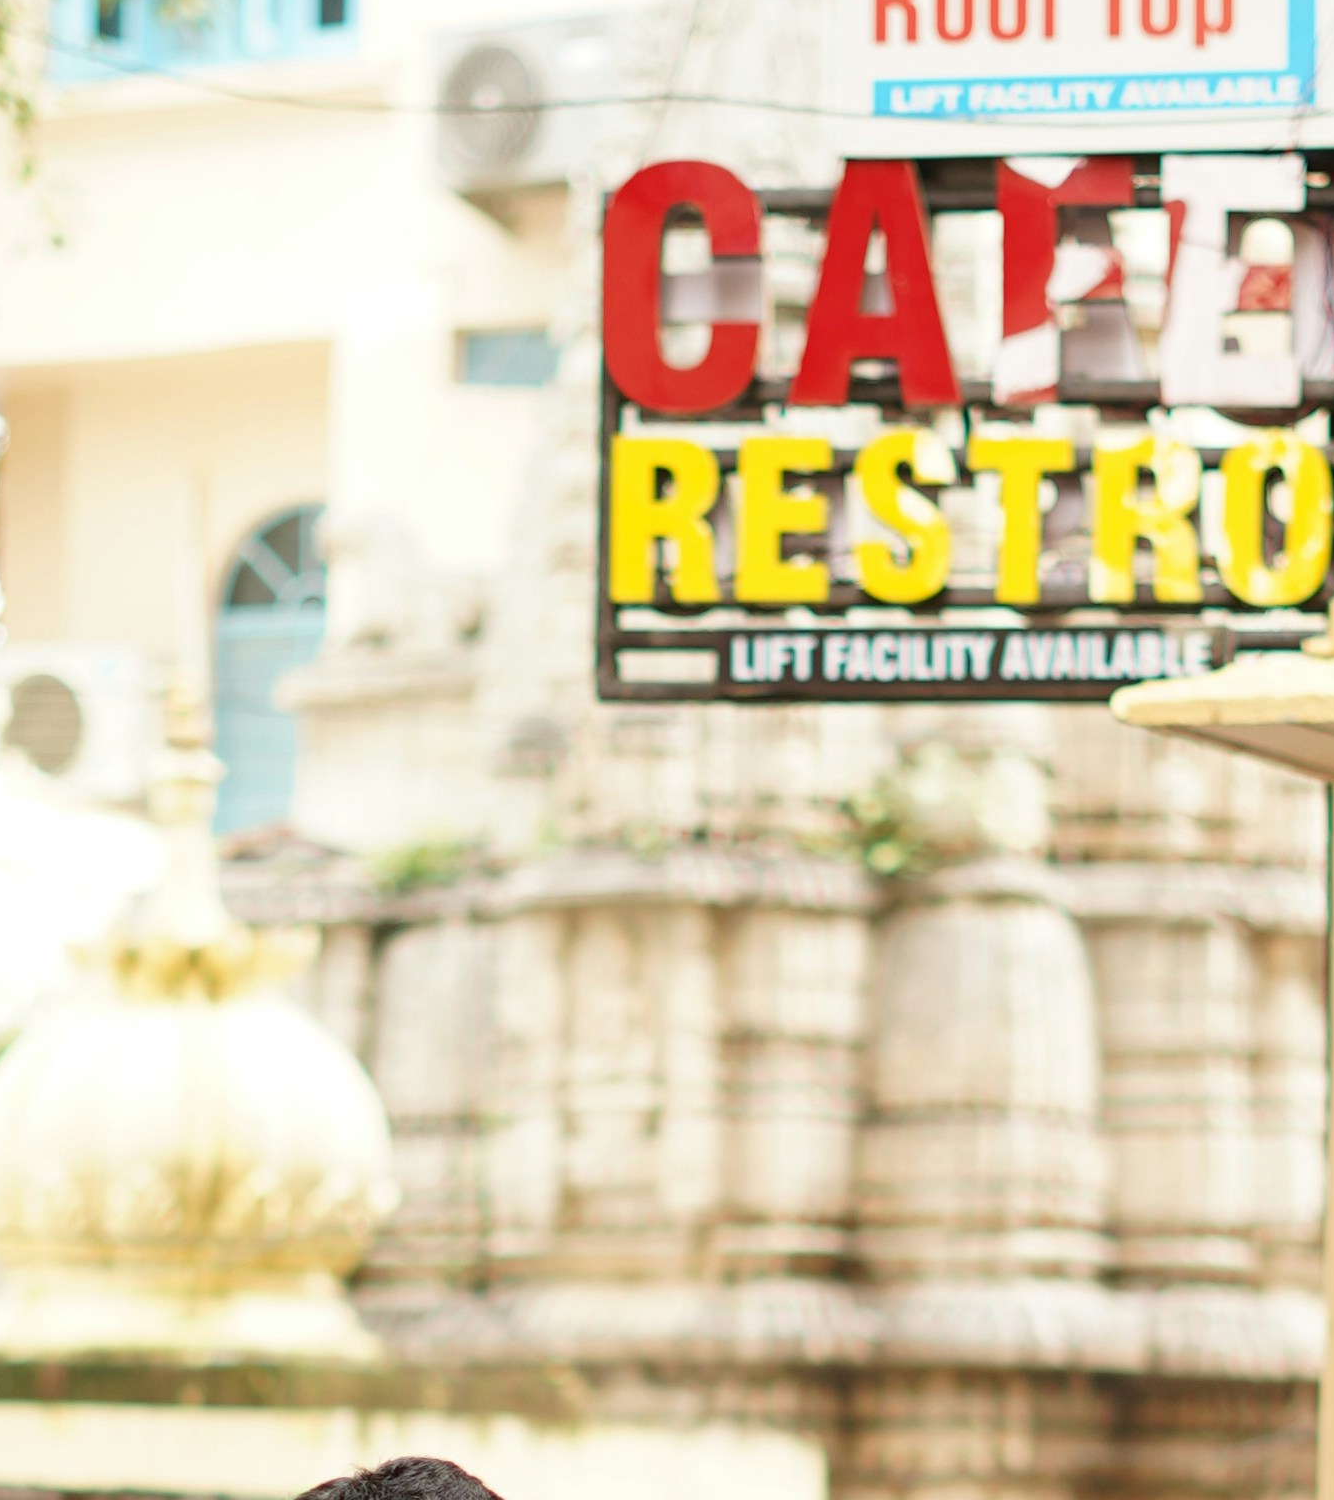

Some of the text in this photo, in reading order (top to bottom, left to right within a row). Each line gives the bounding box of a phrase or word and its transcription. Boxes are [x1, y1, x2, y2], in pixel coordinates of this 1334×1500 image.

[890, 76, 1302, 114] LIFT FACILITY AVAILABLE
[604, 159, 1306, 412] CAFE
[610, 428, 1334, 606] RESTRO
[731, 630, 1214, 682] LIFT FACILITY AVAILABLE
